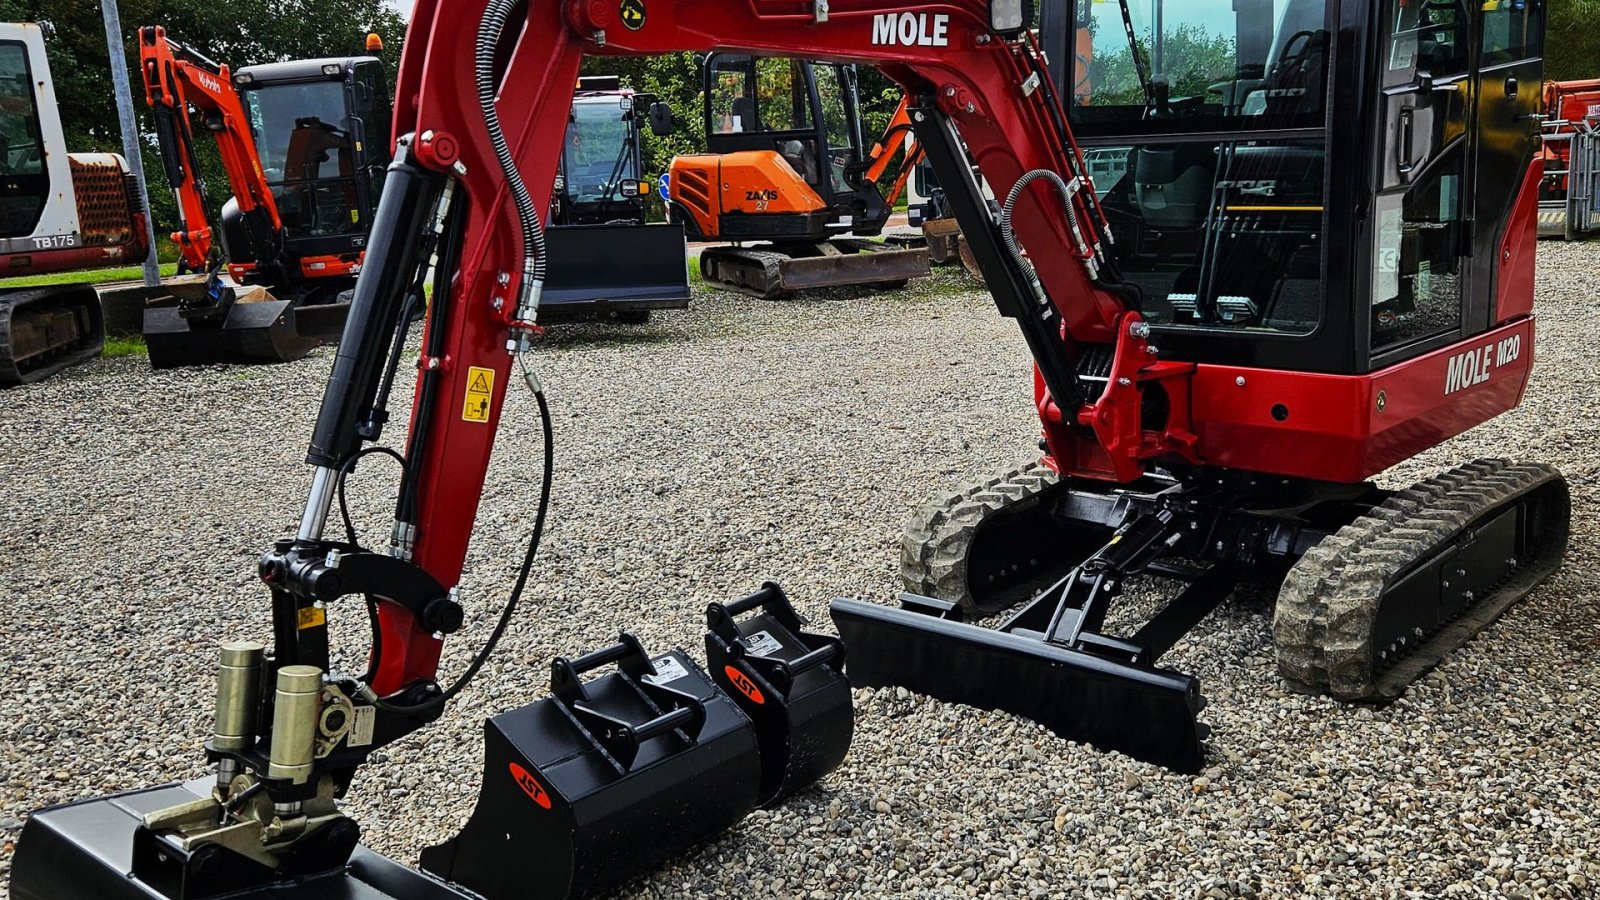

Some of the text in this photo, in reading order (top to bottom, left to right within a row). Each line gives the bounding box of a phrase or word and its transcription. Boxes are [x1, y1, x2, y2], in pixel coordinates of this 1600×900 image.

[872, 12, 949, 46] MOLE
[756, 200, 768, 210] 27
[32, 235, 75, 249] TB175
[1444, 334, 1520, 396] MOLE M20
[733, 674, 757, 697] JST
[518, 774, 543, 800] JST
